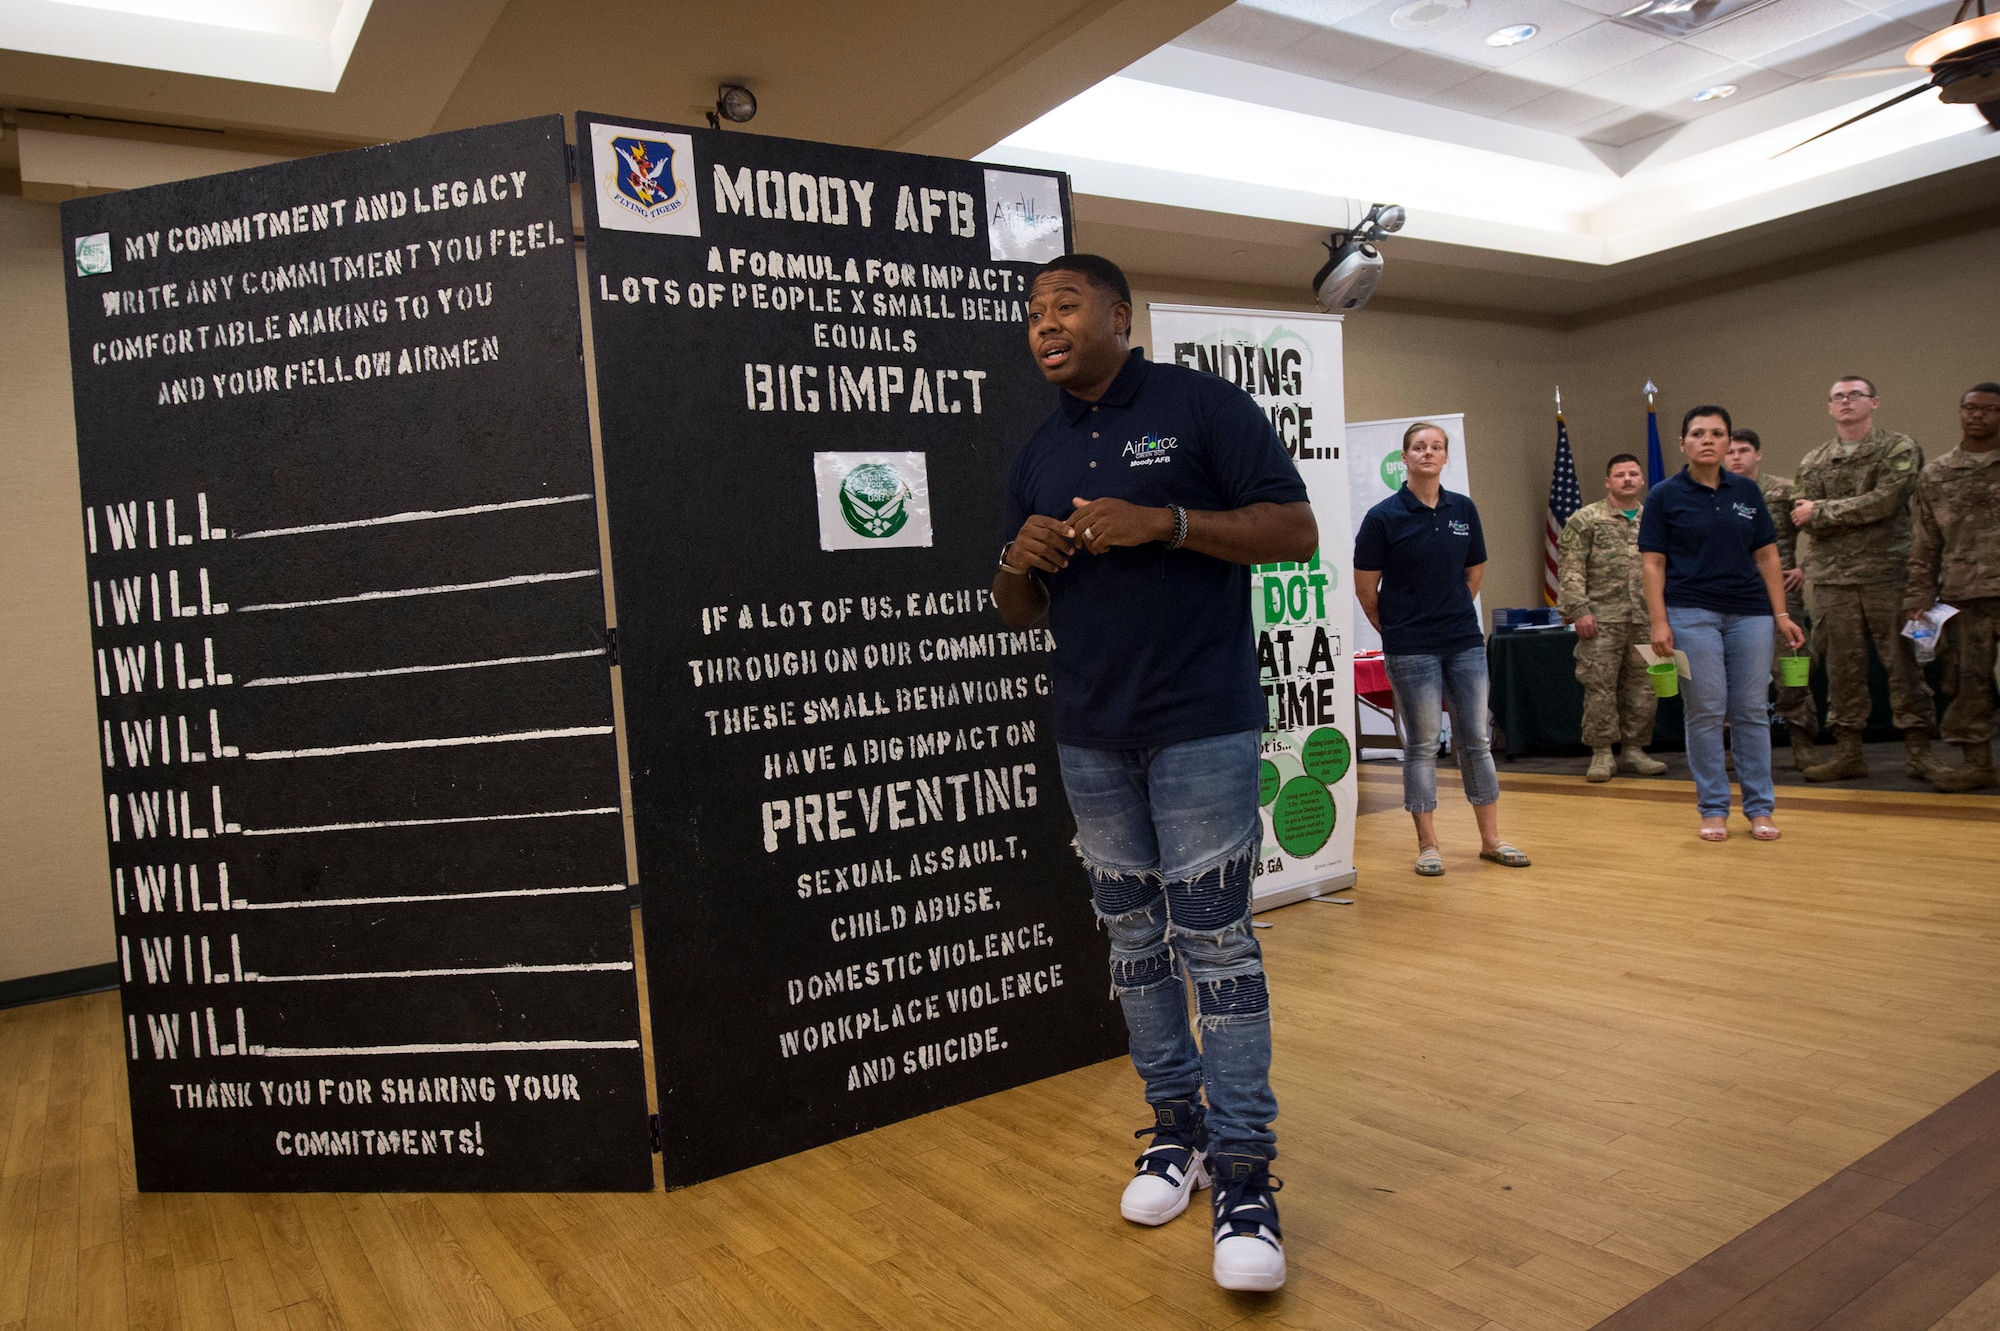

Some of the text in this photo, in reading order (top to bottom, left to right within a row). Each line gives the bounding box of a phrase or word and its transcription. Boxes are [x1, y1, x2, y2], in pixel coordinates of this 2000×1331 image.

[126, 231, 159, 261] MY
[168, 199, 347, 253] COMMITMENT
[355, 191, 407, 223] AND
[414, 171, 526, 214] LEGACY
[614, 194, 682, 218] FLYING TIGERS
[714, 164, 975, 238] MOODY AFB
[102, 220, 564, 317] WRITE ANY COMMITMENT YOU FEEL
[708, 246, 1024, 292] A FORMULA FOR IMPACT:
[93, 282, 492, 365] COMFORTABLE MAKING TO YOU
[600, 275, 680, 305] LOTS
[688, 283, 726, 309] OF
[732, 283, 842, 312] PEOPLE
[851, 290, 865, 314] X
[873, 293, 955, 319] SMALL
[814, 323, 917, 352] EQUALS
[159, 336, 498, 405] AND YOUR FELLOW AIRMEN
[745, 364, 986, 414] BIG IMPACT
[1130, 455, 1171, 467] Moody AFB
[1386, 461, 1407, 475] gre
[87, 493, 226, 553] I WILL
[94, 568, 229, 626] I WILL
[702, 606, 728, 635] IF
[739, 605, 753, 629] A
[762, 601, 812, 628] LOT
[822, 598, 852, 623] OF
[861, 596, 901, 620] US,
[907, 590, 970, 616] EACH
[1263, 573, 1329, 624] DOT
[98, 638, 233, 696] I WILL
[688, 650, 817, 687] THROUGH
[825, 647, 857, 673] ON
[864, 642, 912, 668] OUR
[1258, 625, 1335, 678] AT A
[705, 673, 1054, 736] THESE SMALL BEHAVIORS C
[1261, 678, 1335, 732] TIME
[104, 709, 239, 767] I WILL
[765, 720, 1035, 779] HAVE A BIG IMPACT ON
[109, 786, 241, 842] I WILL
[761, 763, 1037, 853] PREVENTING
[116, 862, 249, 915] I WILL
[798, 836, 1026, 898] SEXUAL ASSAULT,
[1267, 857, 1283, 874] GA
[831, 887, 1000, 941] CHILD ABUSE,
[122, 934, 259, 984] I WILL
[788, 923, 1053, 1006] DOMESTIC VIOLENCE,
[129, 1008, 265, 1059] I WILL
[780, 965, 1063, 1057] WORKPLACE VIOLENCE
[848, 1027, 1007, 1090] AND SUICIDE.
[170, 1074, 580, 1108] THANK YOU FOR SHARING YOUR
[276, 1121, 484, 1156] COMMITMENTS!
